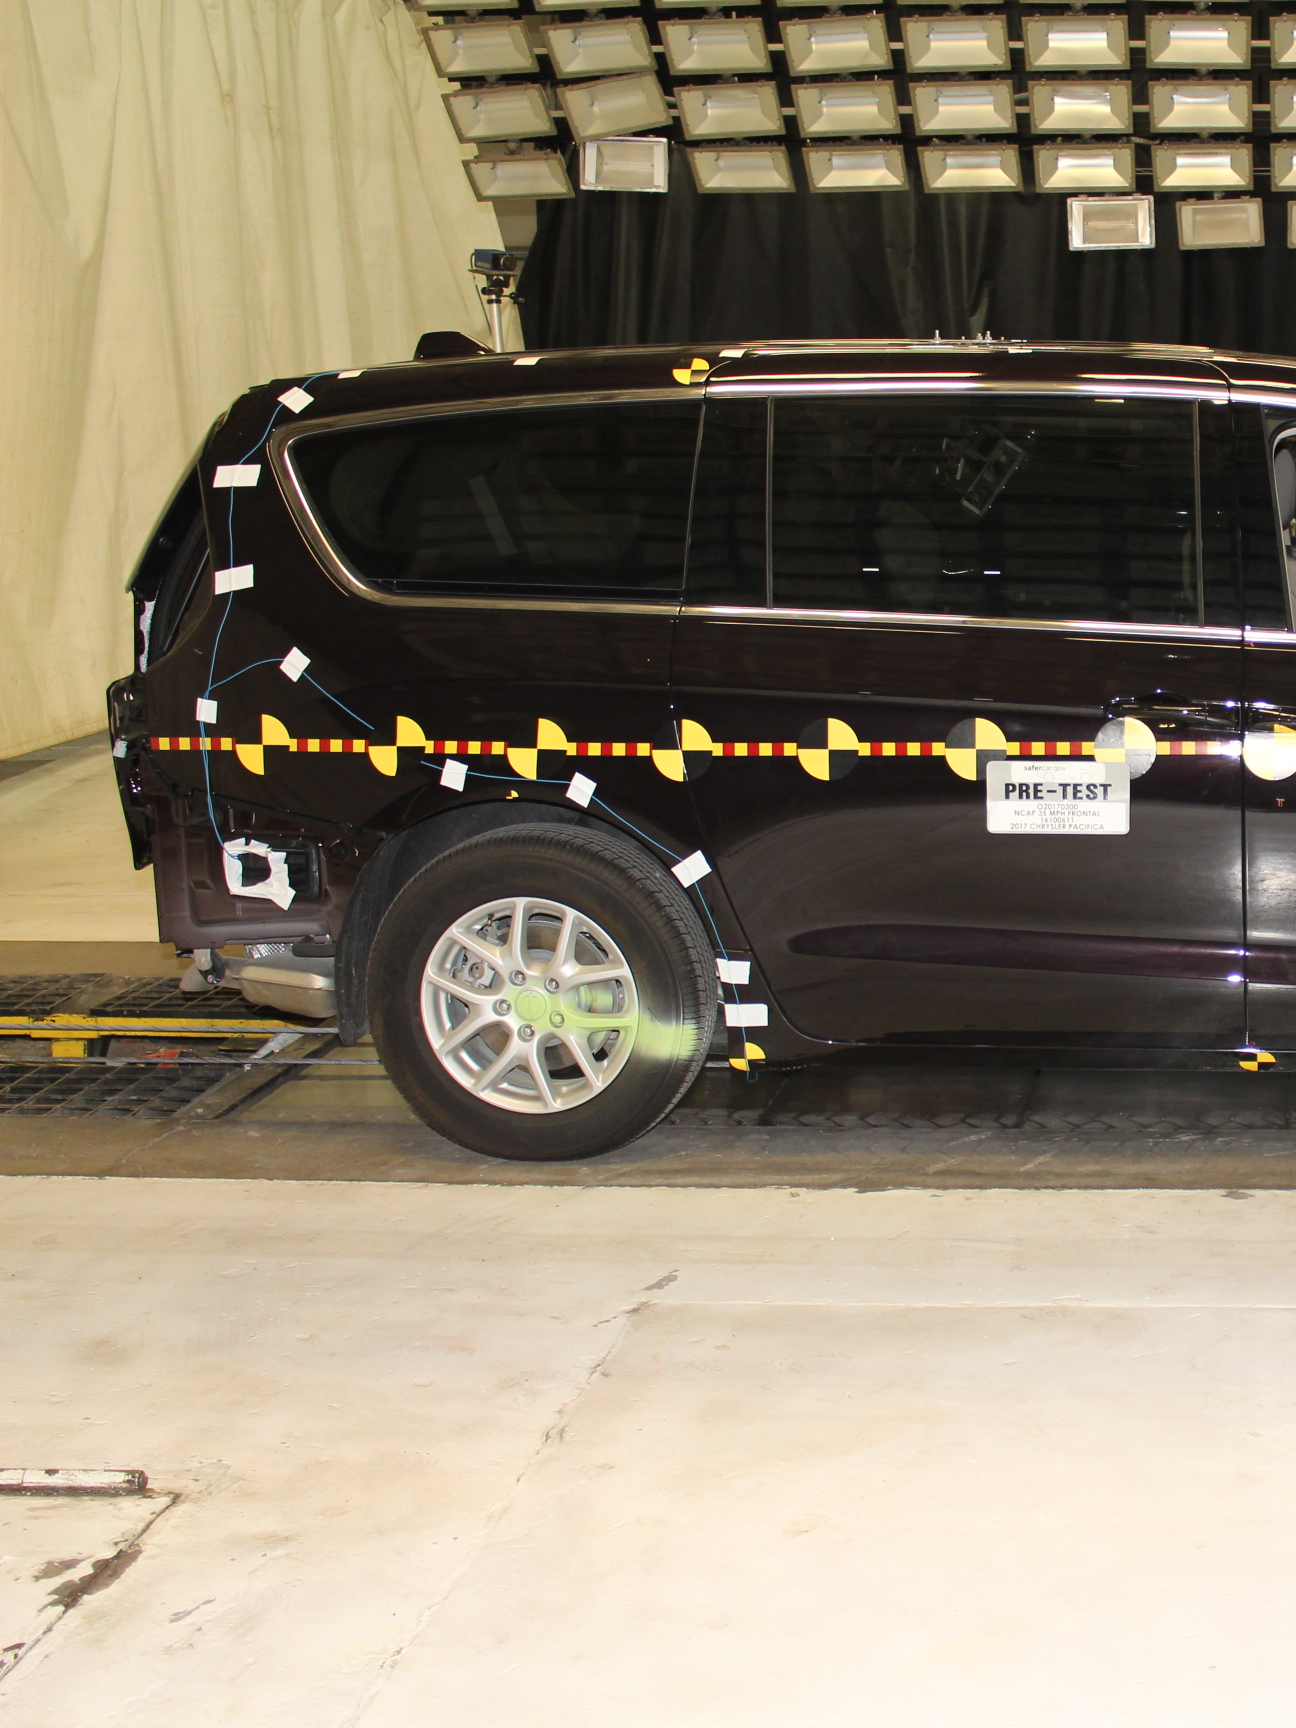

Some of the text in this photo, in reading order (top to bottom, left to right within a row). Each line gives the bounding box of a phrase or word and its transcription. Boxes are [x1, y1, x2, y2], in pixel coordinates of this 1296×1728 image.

[1024, 764, 1067, 772] safercar.gov
[1004, 783, 1112, 800] PRE-TEST
[1068, 810, 1102, 818] FRONTAL
[1040, 816, 1074, 824] 16100611
[1068, 823, 1105, 831] PACIFICA
